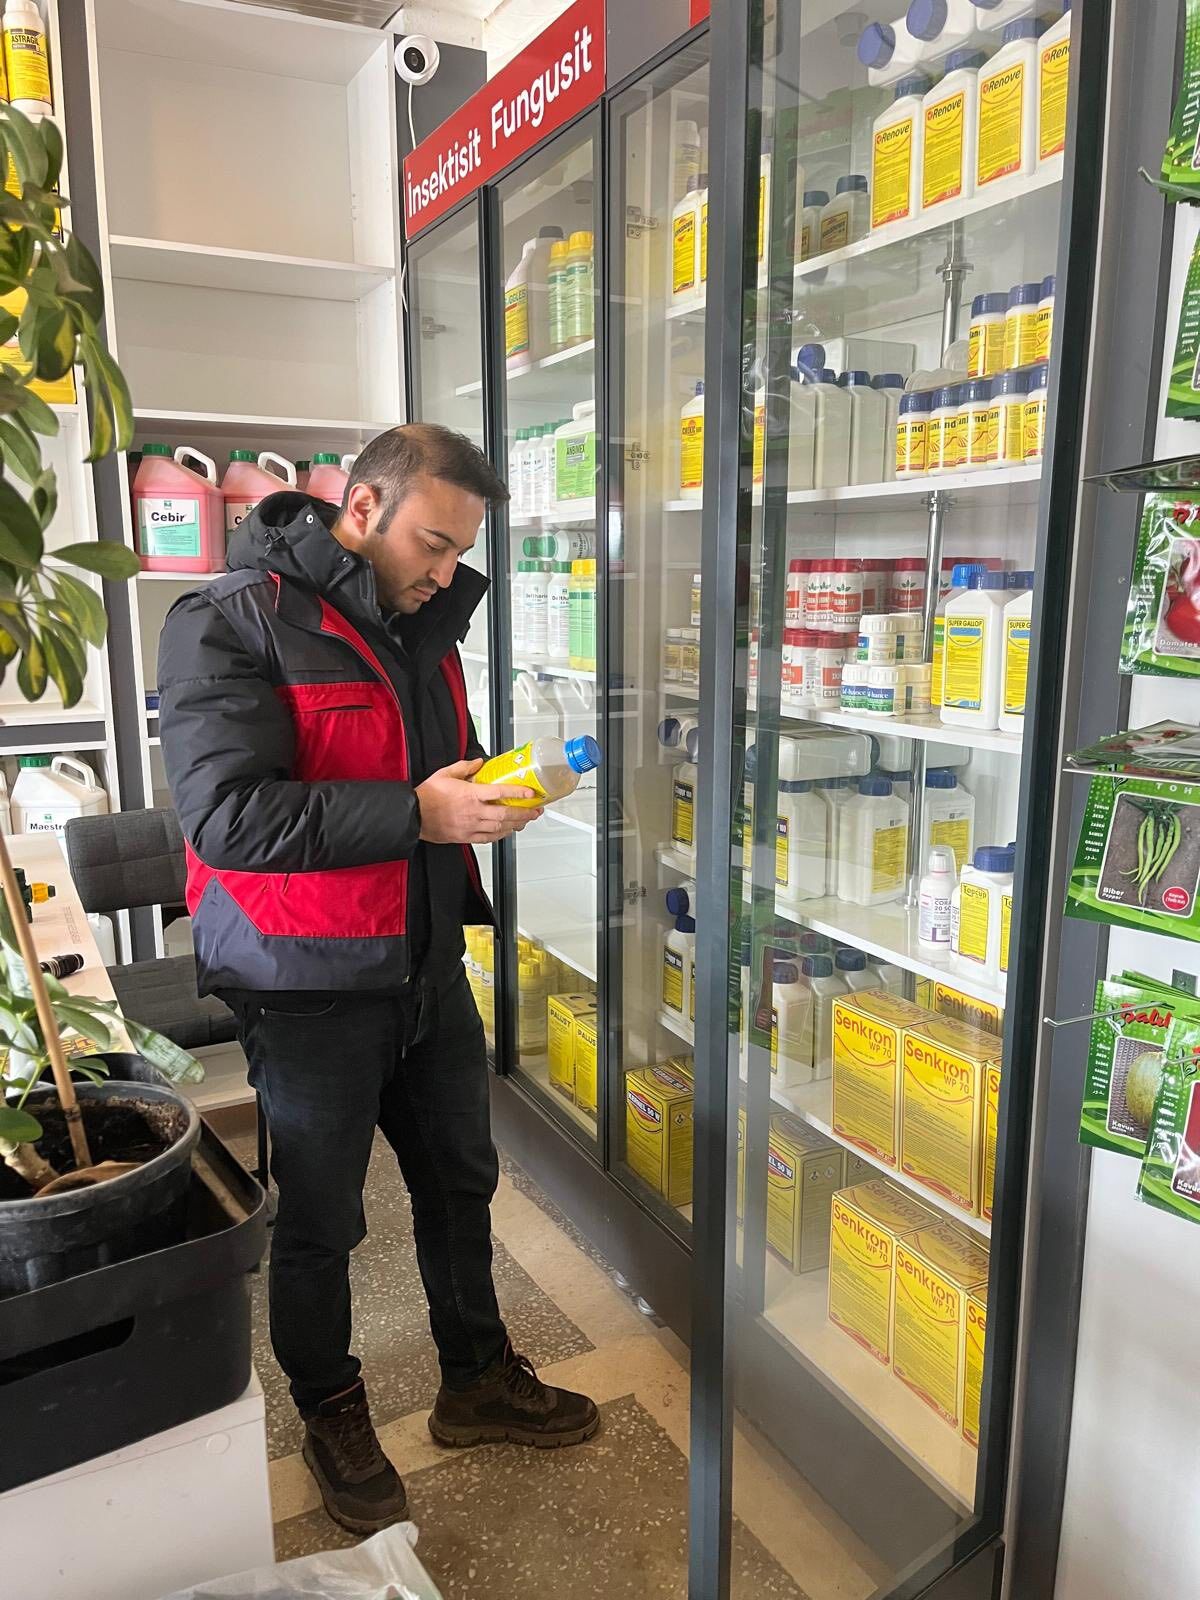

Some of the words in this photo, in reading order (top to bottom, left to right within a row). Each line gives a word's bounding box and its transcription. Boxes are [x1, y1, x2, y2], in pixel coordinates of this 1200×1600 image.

[988, 70, 1021, 93] Renove
[932, 99, 962, 119] Renove
[408, 127, 482, 218] İnsektisit
[491, 25, 593, 149] Fungusit
[881, 124, 910, 144] Renove
[150, 511, 186, 523] Cebir
[234, 515, 243, 526] C
[1009, 621, 1023, 629] SUPER
[1102, 886, 1125, 897] Biber
[936, 986, 994, 1022] Senkron
[834, 1009, 893, 1050] Senkron
[869, 1040, 882, 1055] WP
[881, 1046, 893, 1060] 70
[905, 1038, 970, 1084] Senkron
[943, 1073, 958, 1089] WP
[959, 1078, 971, 1095] 70
[989, 1073, 1000, 1094] S
[1112, 1119, 1135, 1132] Kavun
[833, 1204, 889, 1254] Senkron
[865, 1241, 879, 1256] WP
[878, 1249, 889, 1263] 70
[896, 1250, 956, 1308] Senkron
[931, 1295, 944, 1308] WP
[944, 1303, 956, 1319] 70
[968, 1304, 987, 1331] Se
